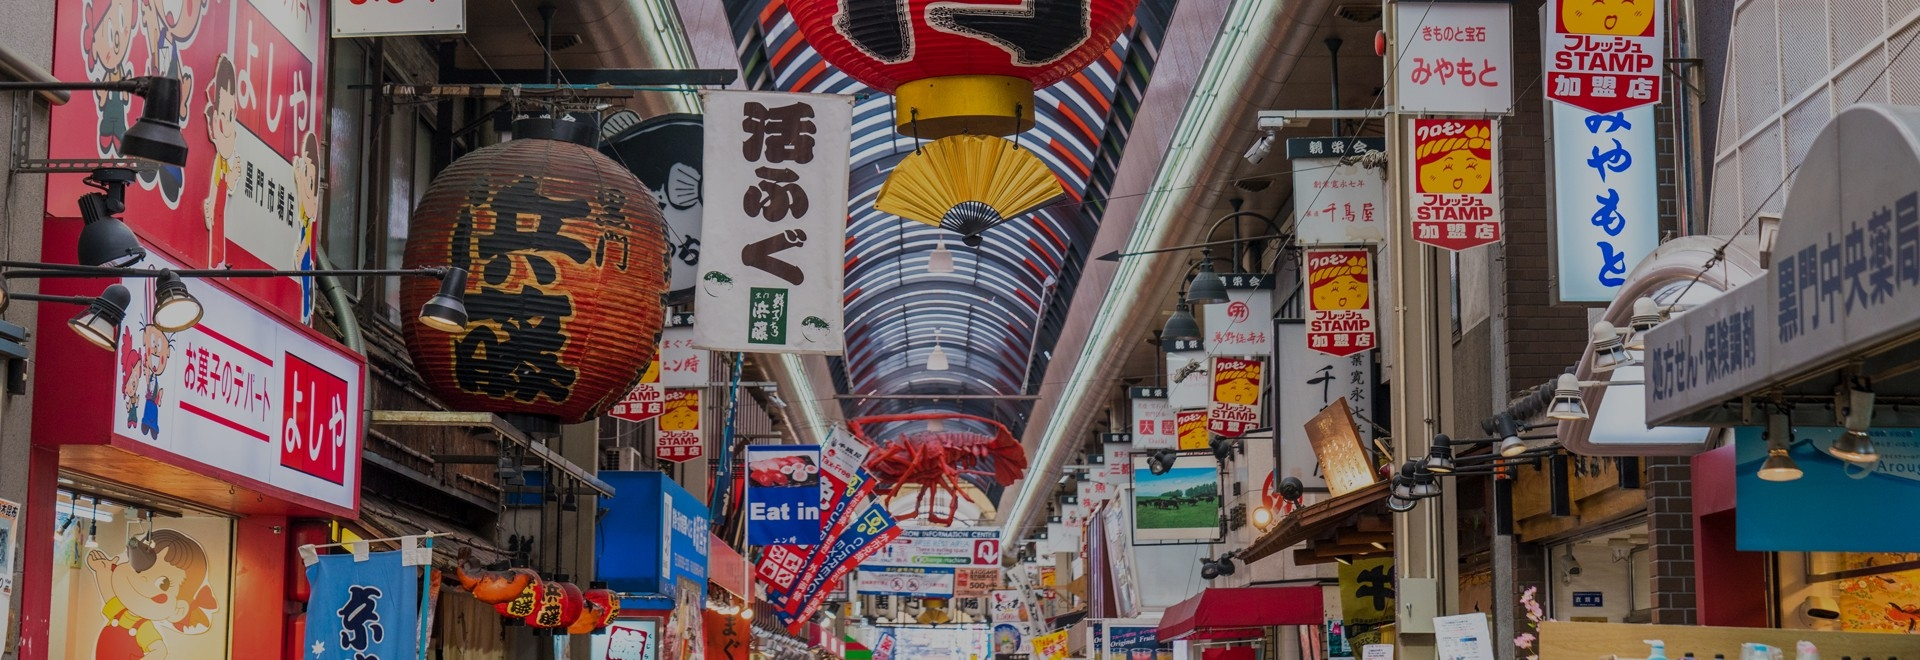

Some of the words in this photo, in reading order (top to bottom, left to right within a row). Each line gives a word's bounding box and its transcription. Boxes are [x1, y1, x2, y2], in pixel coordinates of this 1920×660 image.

[1422, 26, 1486, 43] きものと宝石
[1564, 34, 1643, 54] フレッシュ
[1555, 51, 1654, 73] STAMP
[1411, 57, 1498, 87] みやもと
[237, 19, 310, 155] よしや
[1554, 76, 1653, 100] 加盟店
[1417, 121, 1466, 142] クロモン
[245, 161, 295, 228] 黒門市場店
[742, 101, 817, 286] 活ふぐ
[1423, 194, 1484, 206] フレッシュ
[1585, 112, 1632, 287] みやもと
[1322, 202, 1375, 222] 千鳥屋
[1417, 206, 1493, 221] STAMP
[1418, 223, 1495, 241] 加盟店
[1310, 254, 1348, 270] クロモン
[1778, 191, 1920, 345] 黒門中央薬局
[672, 315, 694, 325] 栄会
[1315, 311, 1363, 320] フレッシュ
[1311, 319, 1371, 332] STAMP
[1312, 333, 1375, 348] 加盟店
[1217, 361, 1247, 372] クロモン
[183, 342, 271, 423] お菓子のデパート
[612, 402, 661, 415] 加盟店
[1212, 409, 1257, 422] STAMP
[1215, 402, 1251, 412] フレッシュ
[284, 370, 345, 472] よしや
[658, 437, 699, 446] STAMP
[659, 447, 701, 456] 加盟店
[821, 454, 852, 480] Tax-Free
[749, 502, 796, 521] Eat
[797, 502, 820, 520] in
[803, 537, 864, 603] CURRENCY
[338, 585, 384, 660] 京
[1110, 637, 1136, 648] Original
[1139, 634, 1156, 643] Fruit
